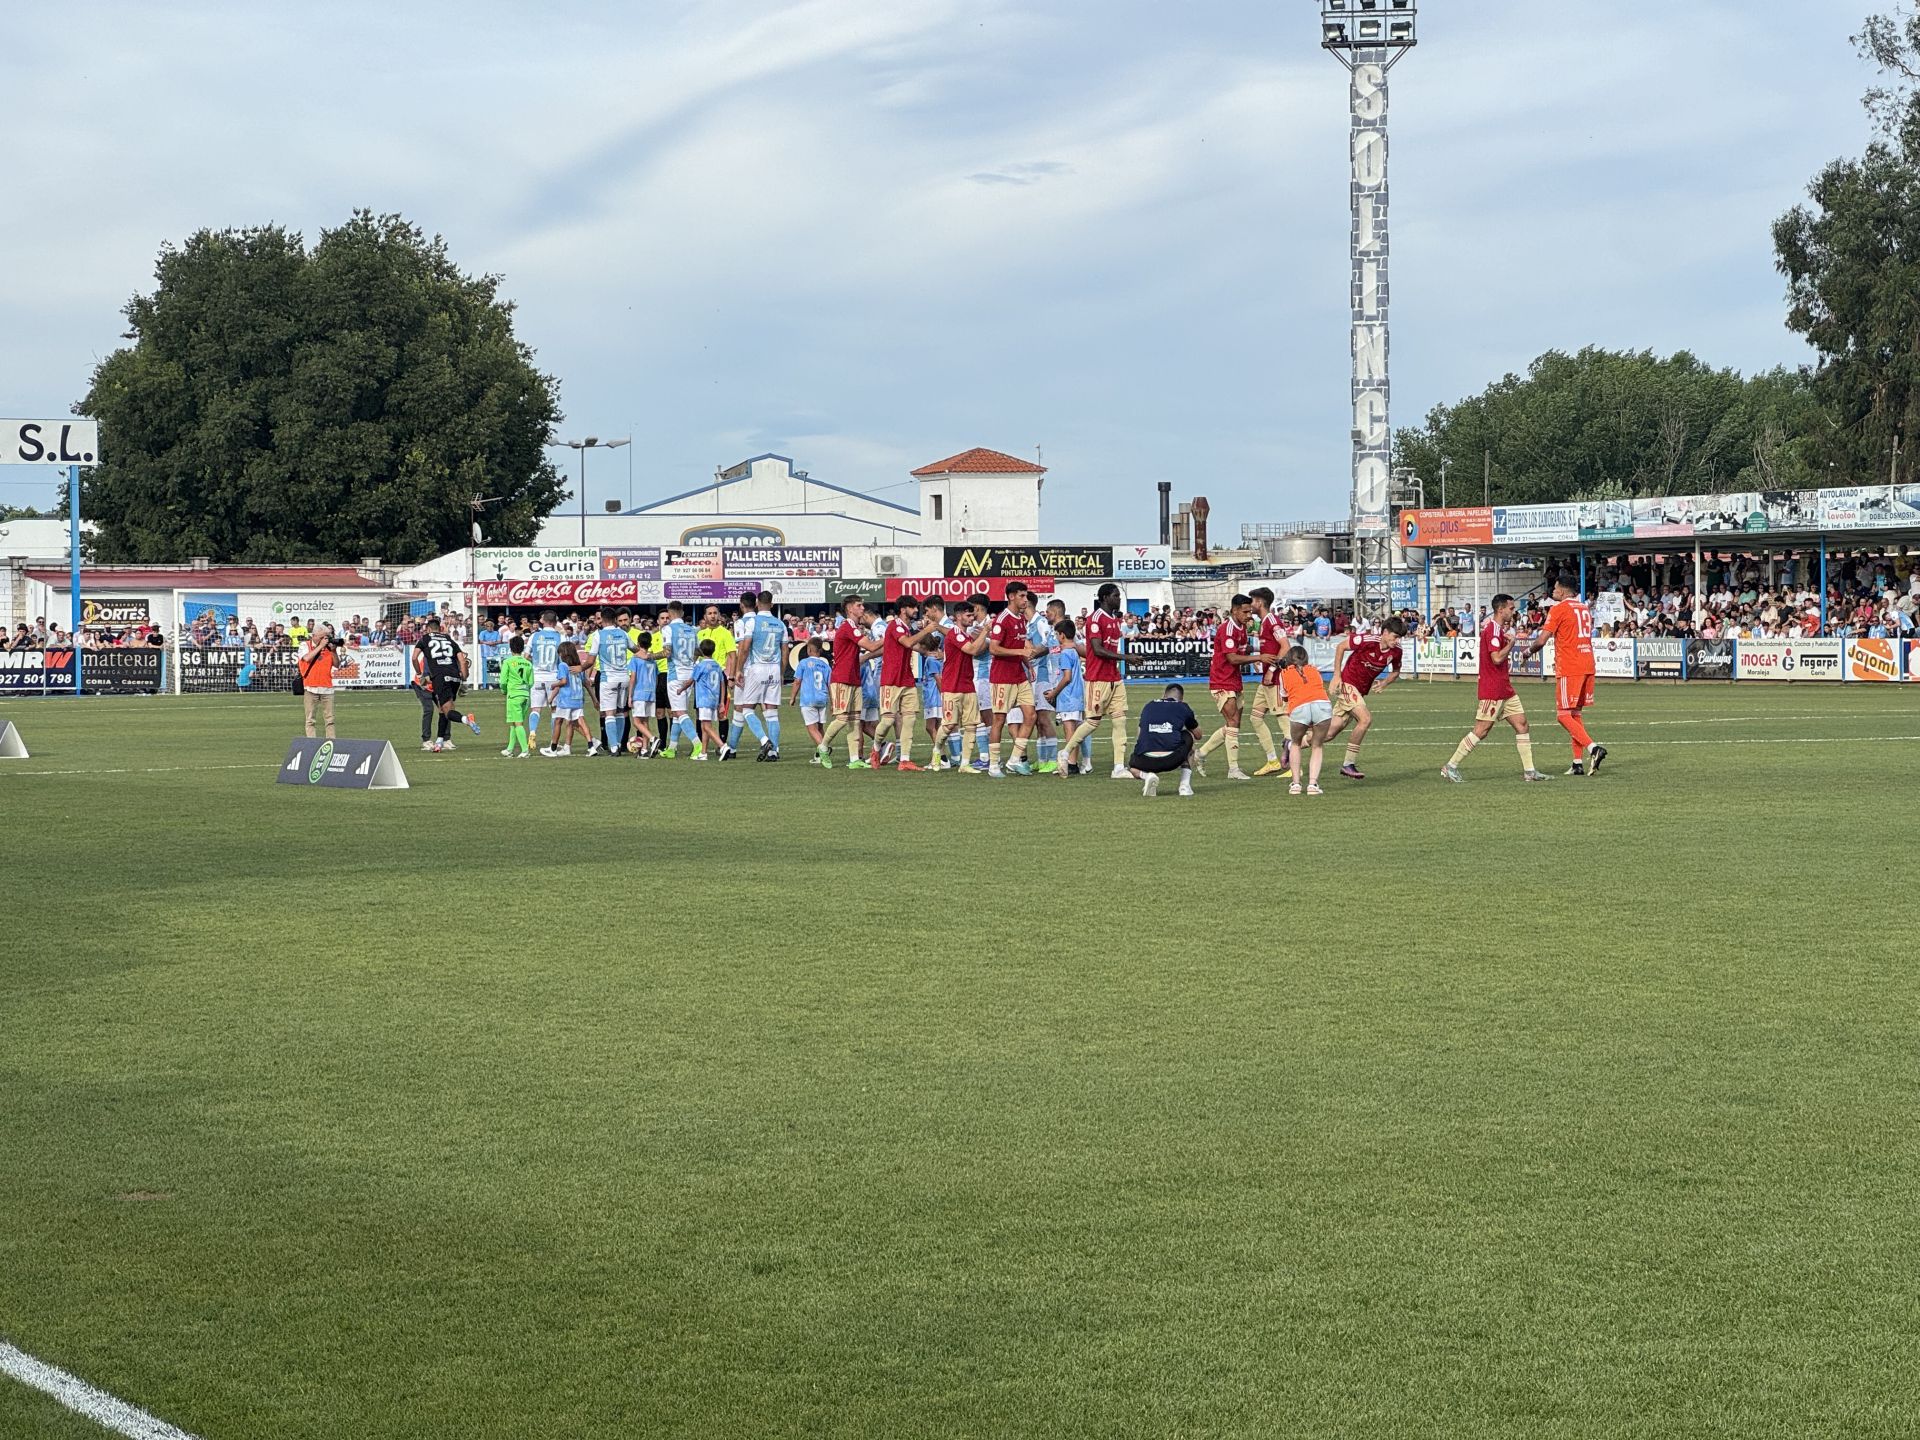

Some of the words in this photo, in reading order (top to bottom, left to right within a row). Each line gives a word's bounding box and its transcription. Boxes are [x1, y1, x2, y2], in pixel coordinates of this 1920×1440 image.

[18, 423, 94, 462] S.L.
[1820, 488, 1858, 499] AUTOLAVADO
[474, 549, 523, 558] Servicios
[527, 549, 540, 558] de
[544, 548, 598, 558] Jardinería
[724, 550, 781, 562] TALLERES
[784, 547, 840, 562] VALENTÍN
[528, 560, 595, 572] Cauria
[1001, 555, 1037, 569] ALPA
[1039, 553, 1104, 568] VERTICAL
[1117, 560, 1166, 571] FEBEJO
[1000, 569, 1031, 577] PINTURAS
[1038, 569, 1069, 577] TRABAJOS
[1069, 568, 1105, 576] VERTICALES
[829, 580, 858, 594] Teresa
[285, 599, 335, 614] gonzález
[1573, 608, 1592, 638] 13
[428, 640, 453, 659] 25
[763, 632, 776, 653] 4
[1637, 642, 1683, 657] TECNICAURIA
[0, 651, 74, 669] MRW
[536, 644, 557, 671] 10
[606, 644, 627, 667] 15
[364, 660, 401, 668] Manuel
[23, 673, 45, 684] 501
[49, 673, 73, 684] 798
[1747, 669, 1770, 677] Moraleja
